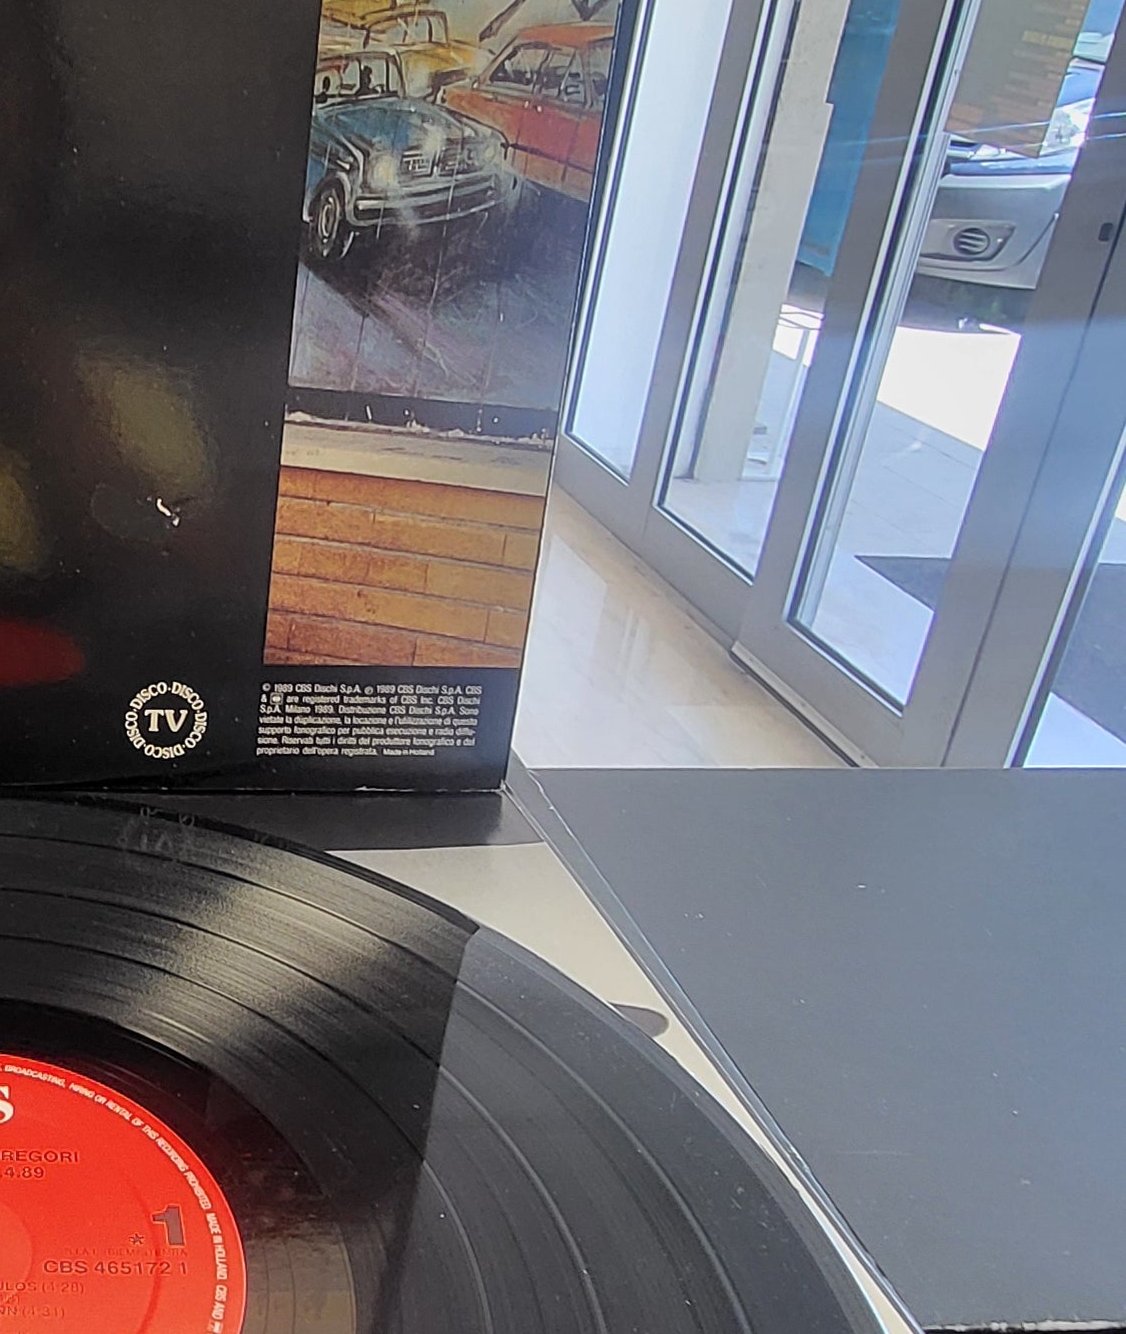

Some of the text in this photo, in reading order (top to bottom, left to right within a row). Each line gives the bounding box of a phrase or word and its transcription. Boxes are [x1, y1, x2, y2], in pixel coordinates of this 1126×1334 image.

[144, 709, 188, 733] TV
[151, 1205, 186, 1246] 1
[43, 1260, 88, 1274] CBS
[94, 1261, 171, 1275] 465172
